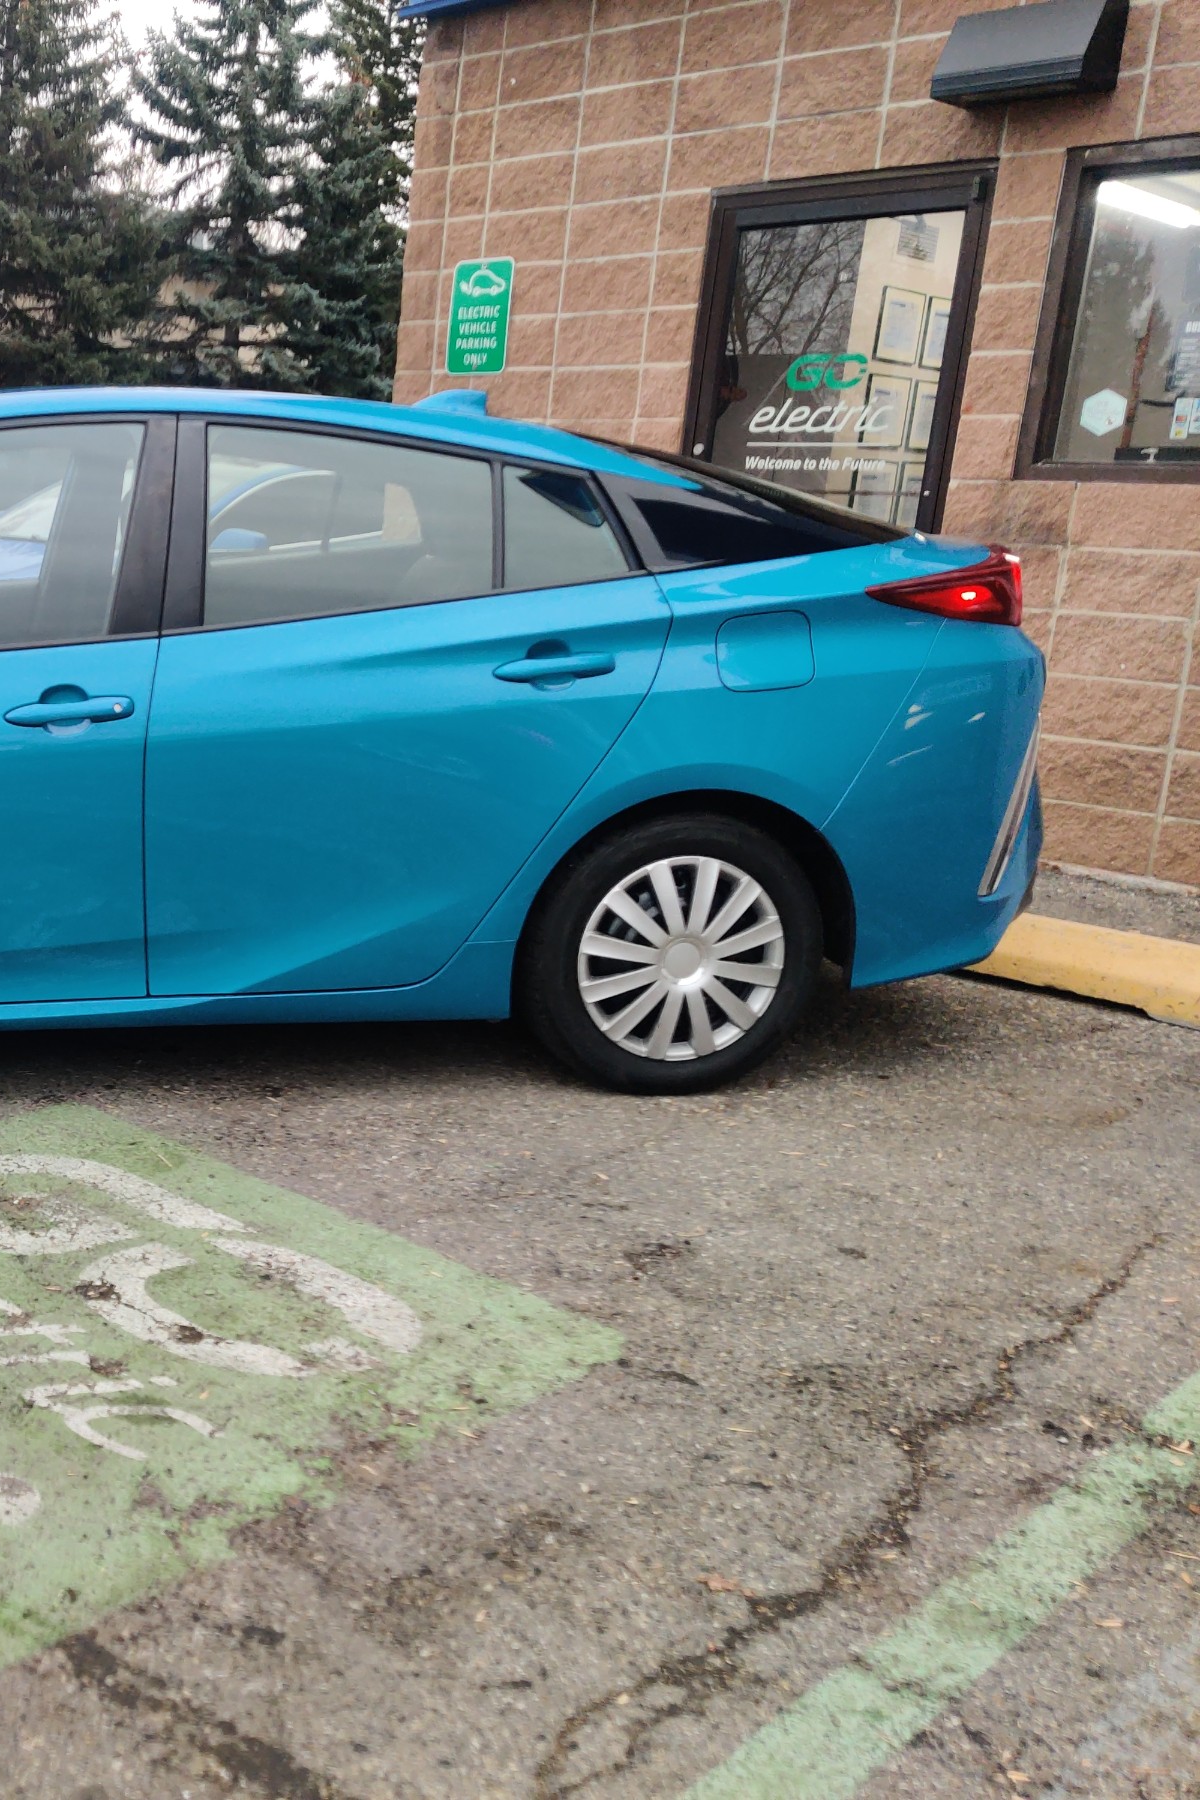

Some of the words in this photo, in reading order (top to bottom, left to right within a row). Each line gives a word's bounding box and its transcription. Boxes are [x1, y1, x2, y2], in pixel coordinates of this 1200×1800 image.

[458, 305, 501, 320] ELECTRIC
[459, 321, 497, 335] VEHICLE
[455, 337, 497, 350] PARKING
[463, 353, 488, 366] ONLY
[786, 353, 868, 391] GO
[748, 397, 894, 433] electric
[745, 455, 802, 471] Welcome
[803, 456, 817, 471] to
[818, 456, 839, 471] the
[841, 457, 886, 471] Future
